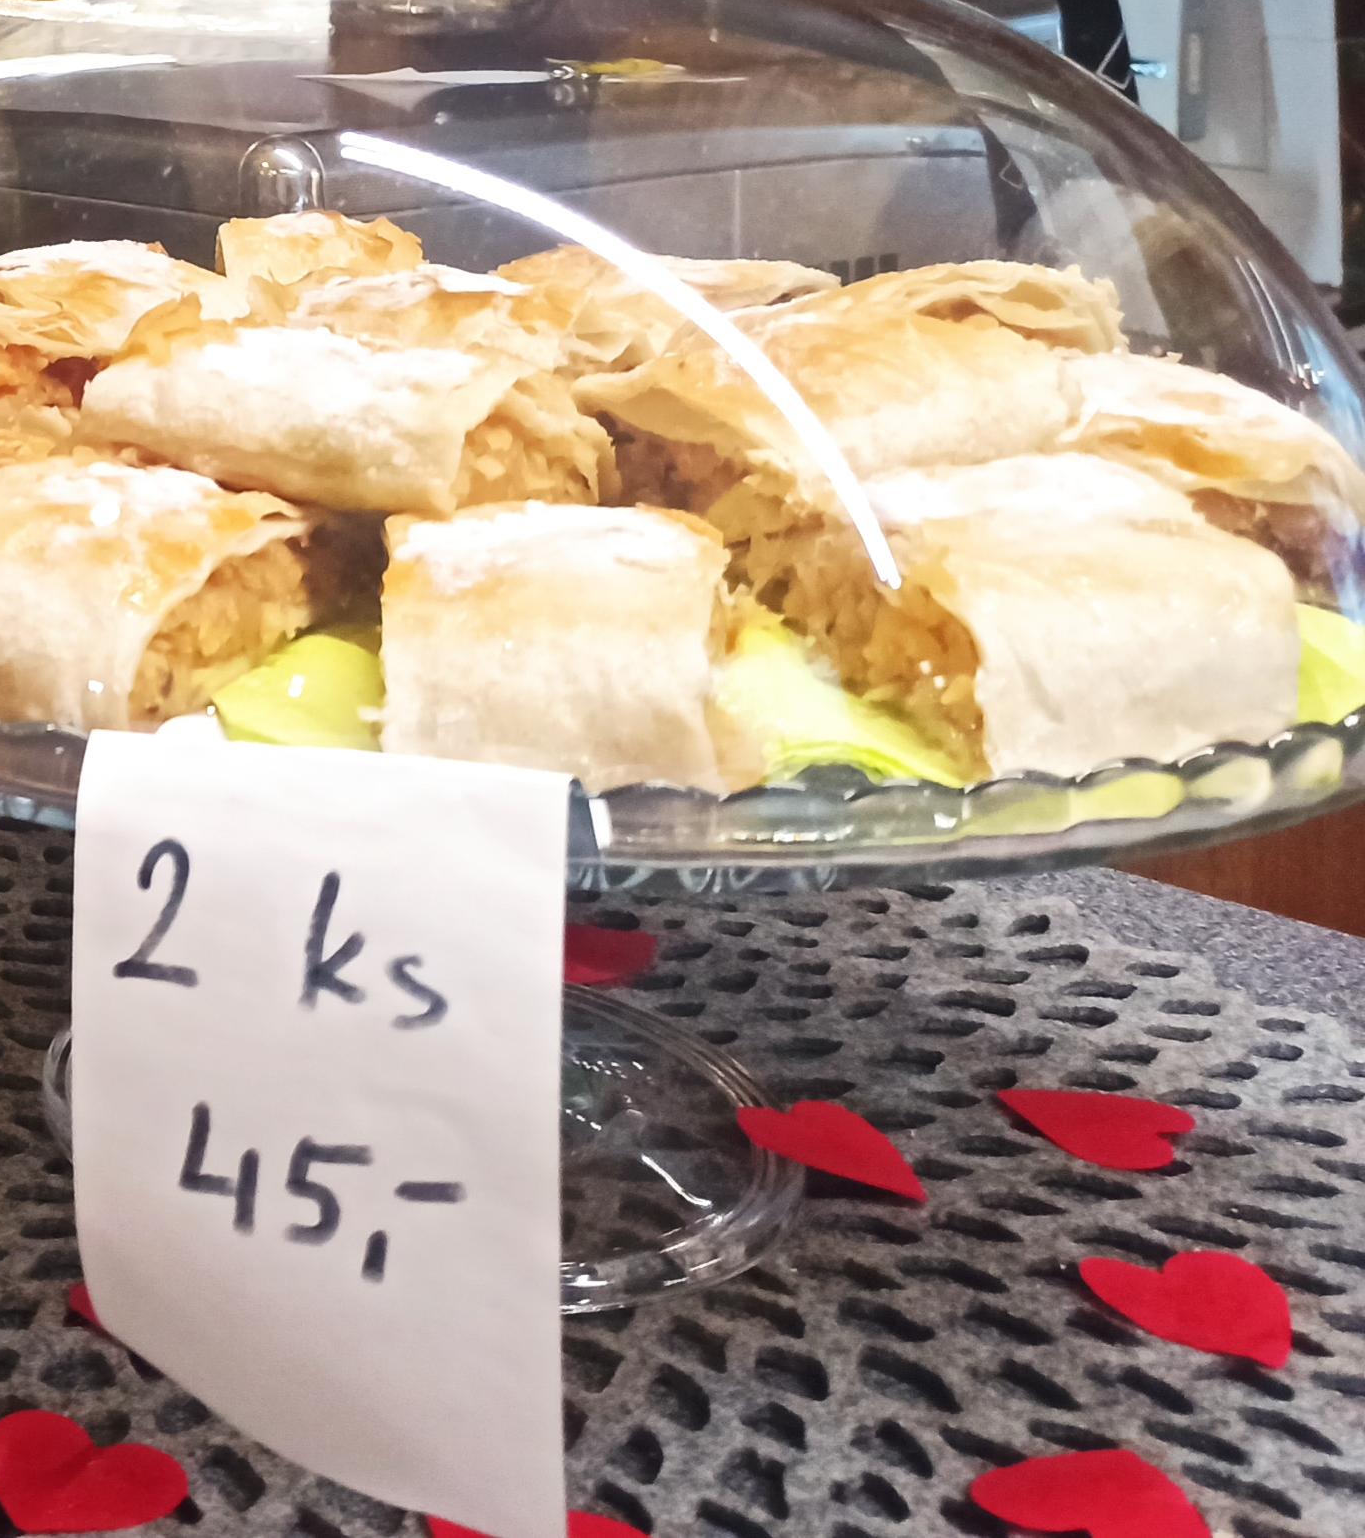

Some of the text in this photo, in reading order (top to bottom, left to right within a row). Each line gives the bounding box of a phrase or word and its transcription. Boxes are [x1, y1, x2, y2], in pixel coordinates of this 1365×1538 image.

[112, 838, 449, 1030] 2 ks
[178, 1101, 466, 1284] 45,-
